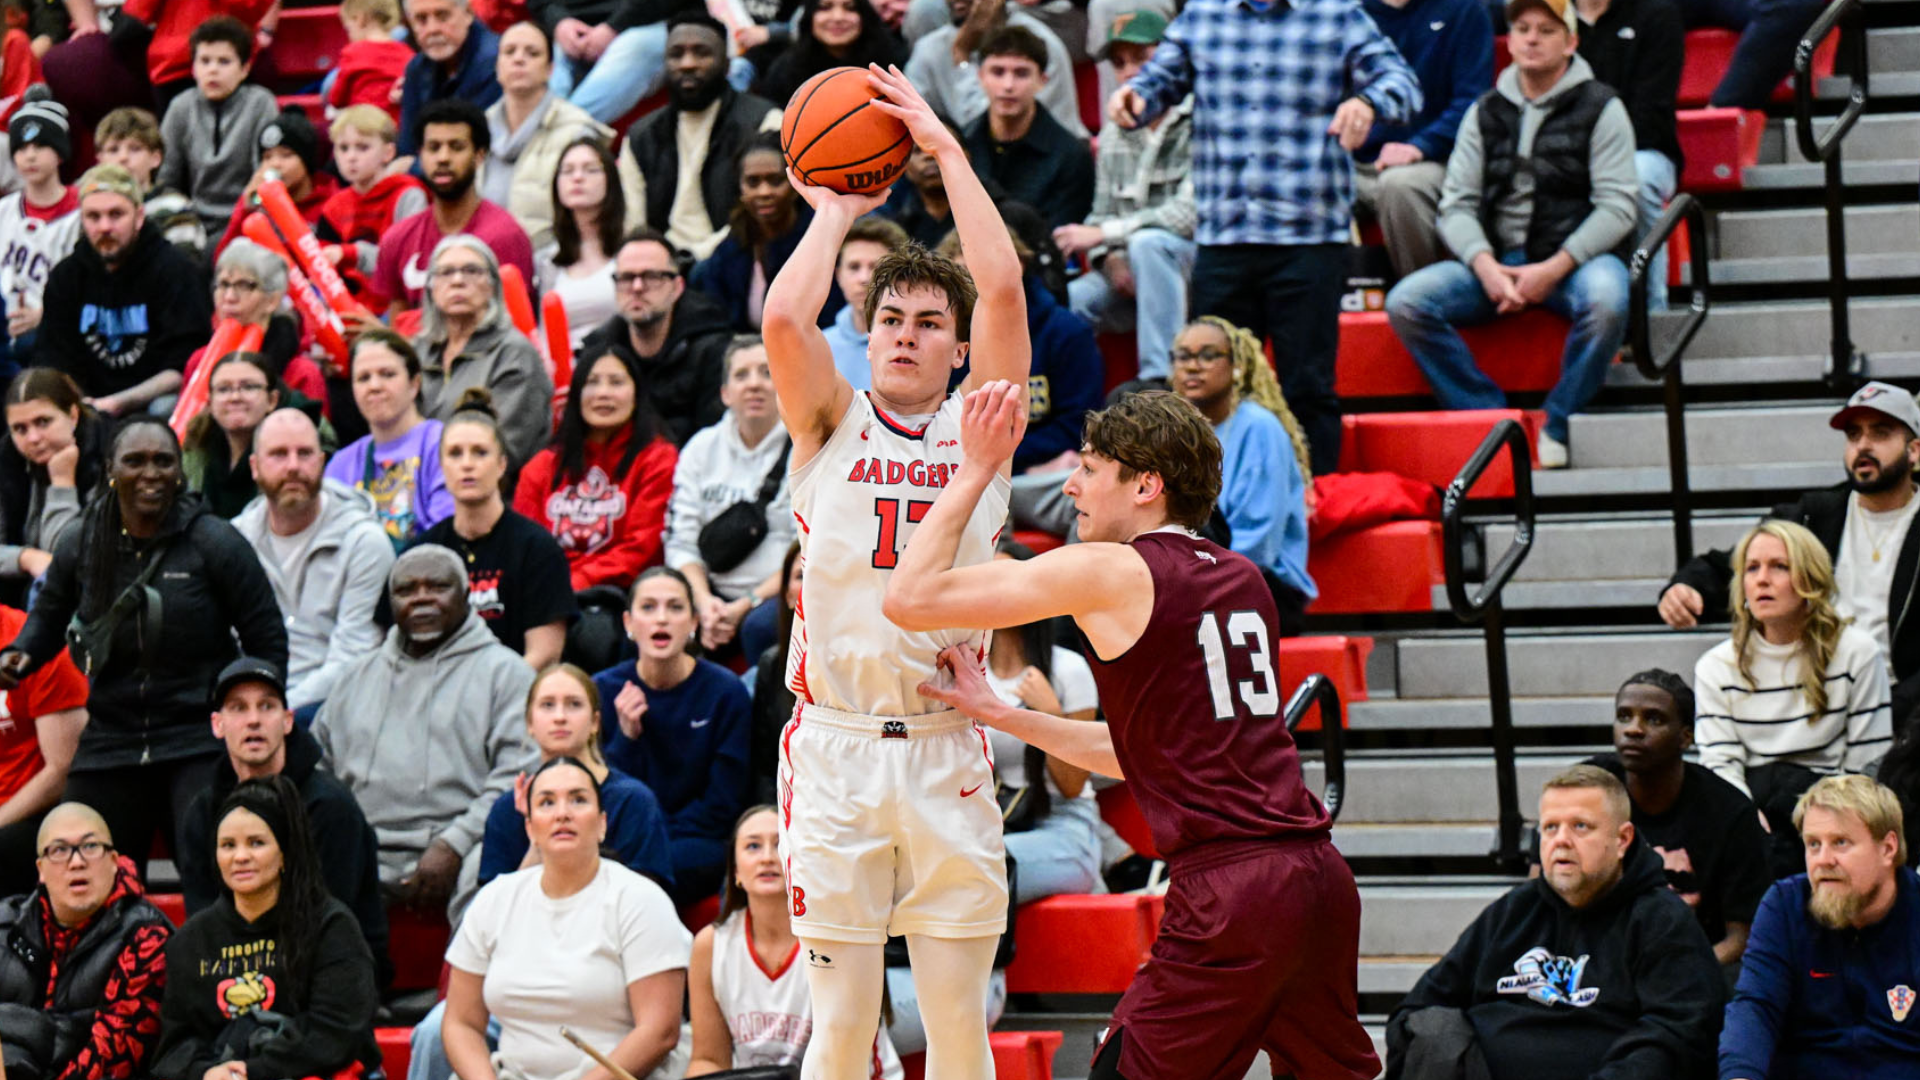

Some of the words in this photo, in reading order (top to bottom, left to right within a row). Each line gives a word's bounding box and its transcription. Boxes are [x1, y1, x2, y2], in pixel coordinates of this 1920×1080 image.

[872, 497, 935, 570] 1
[1196, 609, 1280, 722] 13
[792, 886, 807, 917] B
[221, 939, 275, 959] TORONTO
